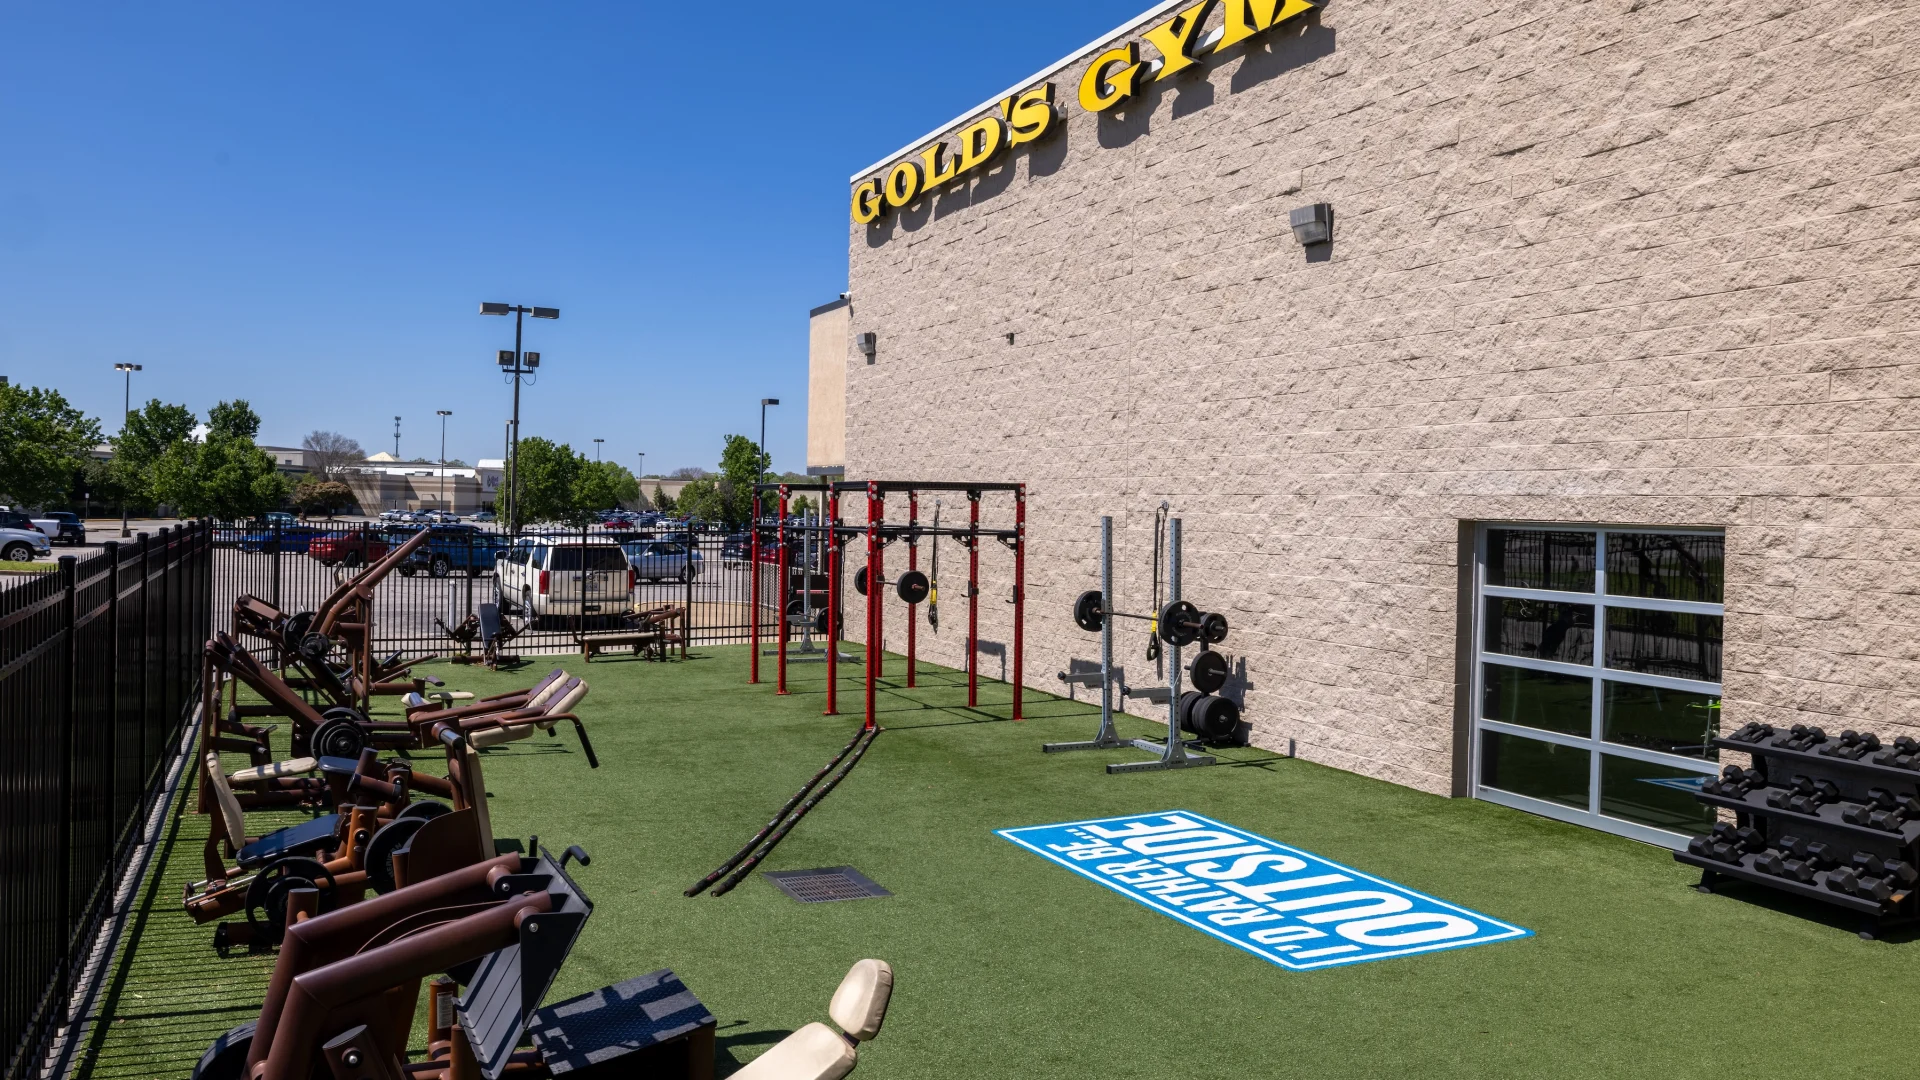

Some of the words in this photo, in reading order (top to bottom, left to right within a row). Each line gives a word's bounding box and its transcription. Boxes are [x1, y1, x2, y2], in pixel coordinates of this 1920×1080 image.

[851, 82, 1053, 225] GOLD'S
[1046, 828, 1132, 861] BE...
[1078, 815, 1479, 946] OUTSIDE
[1096, 859, 1285, 926] RATHER
[1248, 925, 1363, 959] I'D
